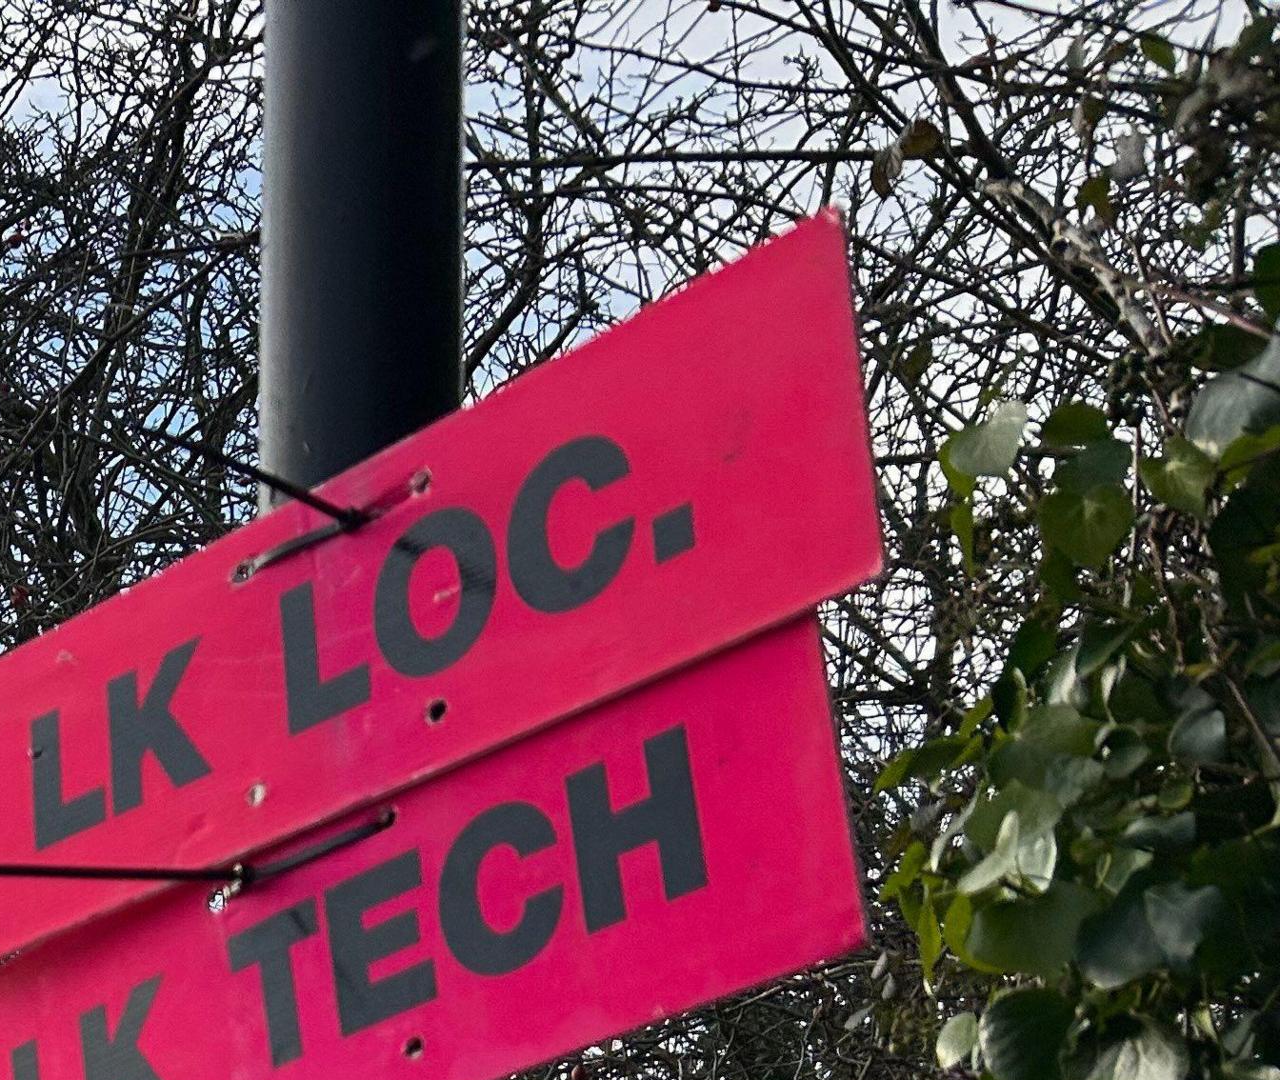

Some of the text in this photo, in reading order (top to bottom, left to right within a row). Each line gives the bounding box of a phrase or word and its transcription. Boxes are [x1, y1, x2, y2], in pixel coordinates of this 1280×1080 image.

[28, 434, 695, 853] LK LOC.
[226, 724, 707, 1067] TECH
